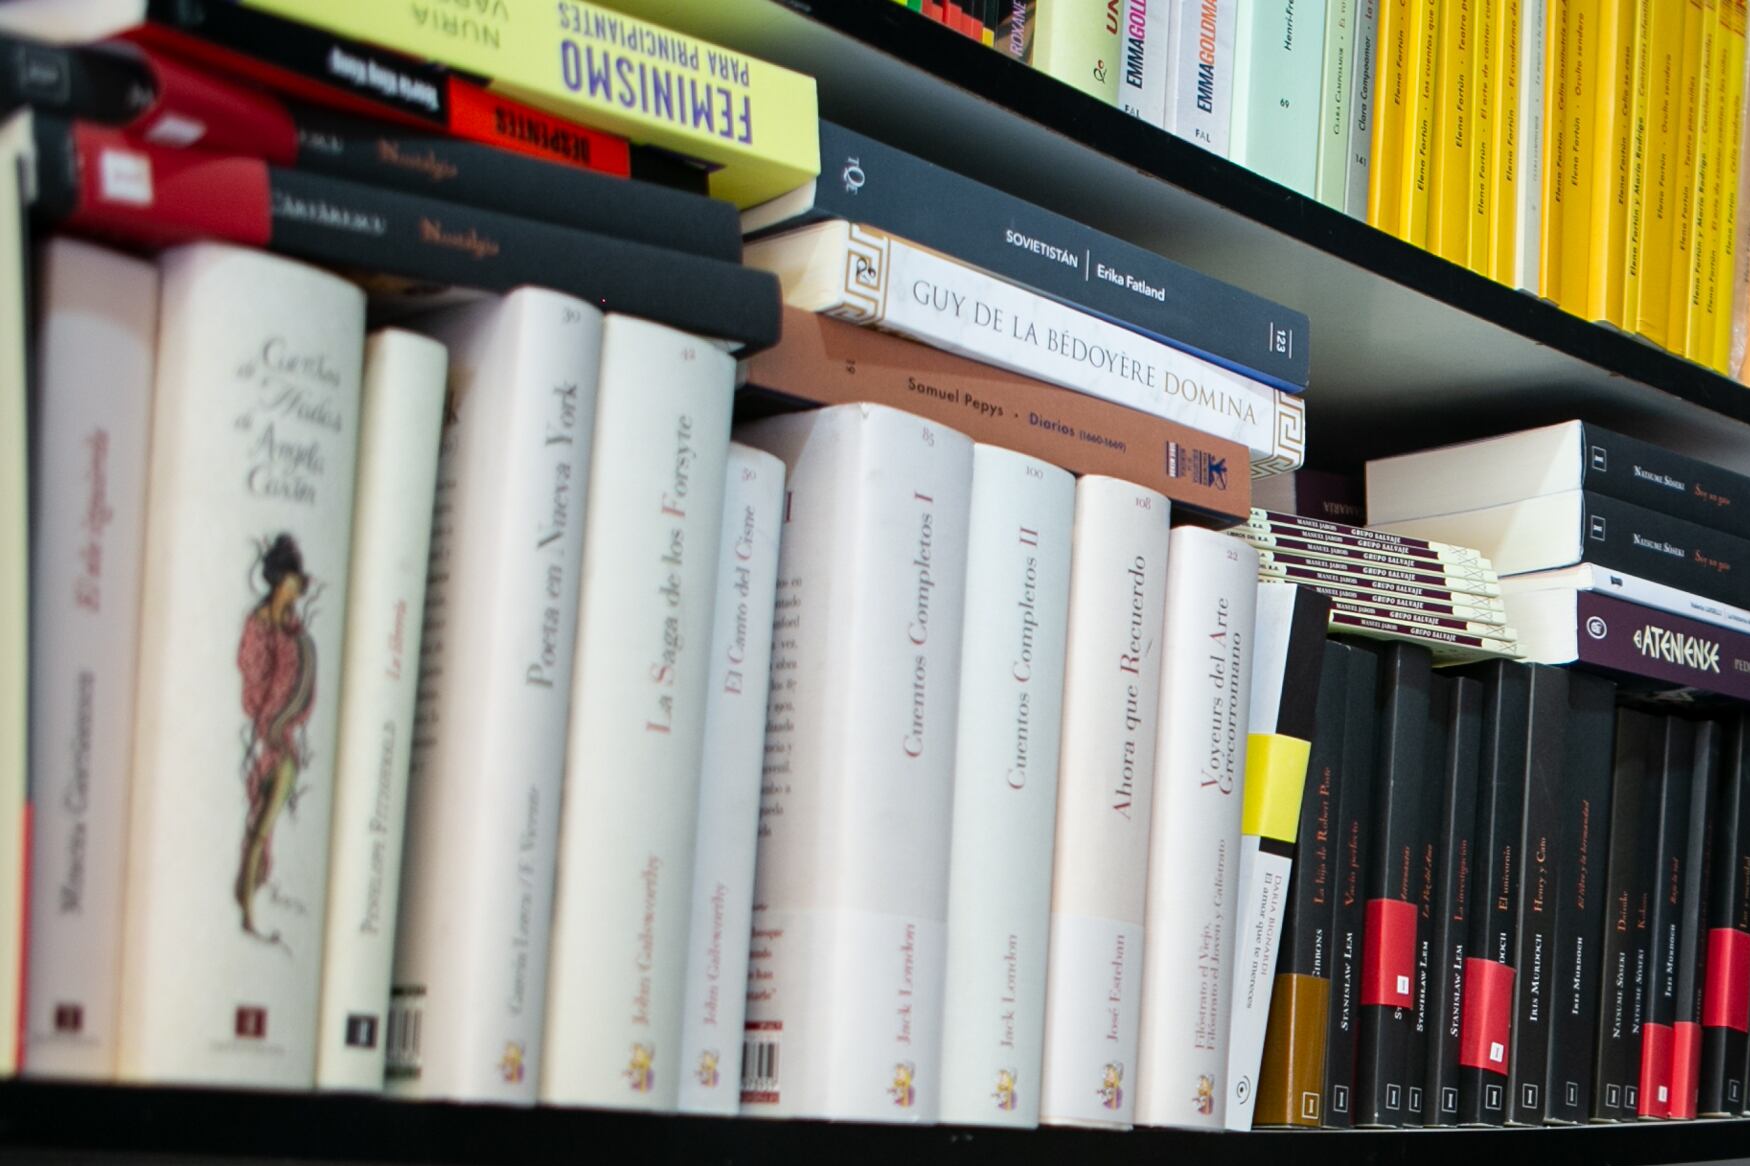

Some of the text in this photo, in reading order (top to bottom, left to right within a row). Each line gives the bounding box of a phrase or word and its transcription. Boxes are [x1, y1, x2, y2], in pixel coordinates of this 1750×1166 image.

[412, 7, 499, 48] NURIA
[558, 2, 750, 86] PARA PRINCIPIANTES
[561, 40, 754, 145] FEMINISMO
[1358, 36, 1371, 131] Clara Campoamor
[1196, 129, 1210, 142] FAL
[1417, 160, 1425, 191] Elena
[1005, 228, 1079, 270] SOVIETISTÁN
[1097, 263, 1166, 302] Erika Fatland
[912, 279, 1258, 427] GUY DE LA BÉDOYÈRE DOMINA
[1275, 329, 1286, 353] 123
[907, 377, 959, 406] Samuel
[962, 391, 1005, 421] Pepys
[1028, 412, 1077, 439] Diarios
[660, 415, 696, 518] Forsyte
[526, 381, 578, 689] Poeta en Nueva York
[662, 528, 683, 566] los
[1226, 550, 1238, 562] 22
[1351, 528, 1374, 539] GRUPO
[659, 570, 682, 607] de
[725, 505, 755, 694] El Canto del Cisne
[650, 615, 683, 687] Saga
[904, 492, 934, 758] Cuentos Completos I
[1410, 628, 1456, 642] GRUPO SALVAJE
[1642, 624, 1720, 674] ATENIENSE
[1007, 526, 1038, 790] Cuentos Completos II
[1112, 554, 1145, 820] Ahora que Recuerdo
[1200, 598, 1228, 788] Voyeurs del Arte
[1219, 632, 1242, 795] Grecorromano
[1260, 887, 1269, 919] amor
[1265, 872, 1272, 885] El
[1498, 894, 1508, 912] El
[1256, 920, 1264, 942] que
[1344, 932, 1353, 952] LEM
[896, 922, 916, 1046] Jack London
[1000, 934, 1018, 1048] Jack London
[1106, 934, 1124, 1042] José Esteban
[1530, 934, 1542, 1022] IRIS MURDOCH
